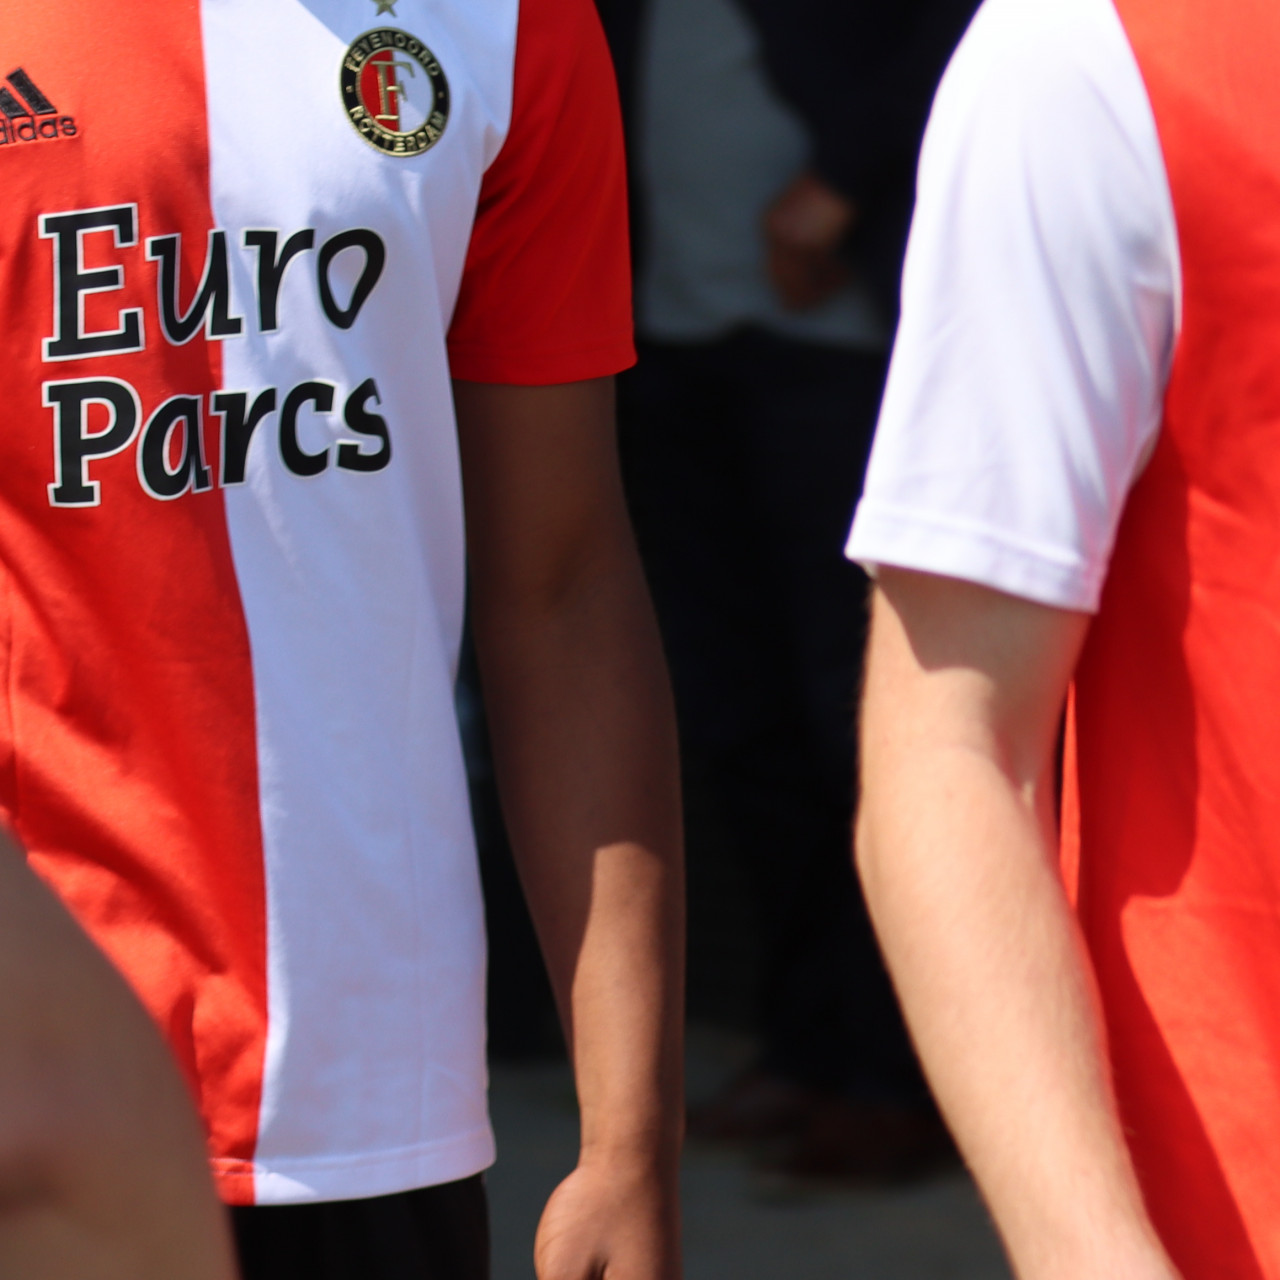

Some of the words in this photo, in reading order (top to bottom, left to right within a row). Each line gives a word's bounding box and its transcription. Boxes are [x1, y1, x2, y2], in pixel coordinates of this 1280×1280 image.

[344, 30, 441, 76] FEYENOORD
[349, 105, 446, 152] ROTTERDAM
[38, 202, 387, 361] Euro
[42, 376, 392, 507] Parcs
